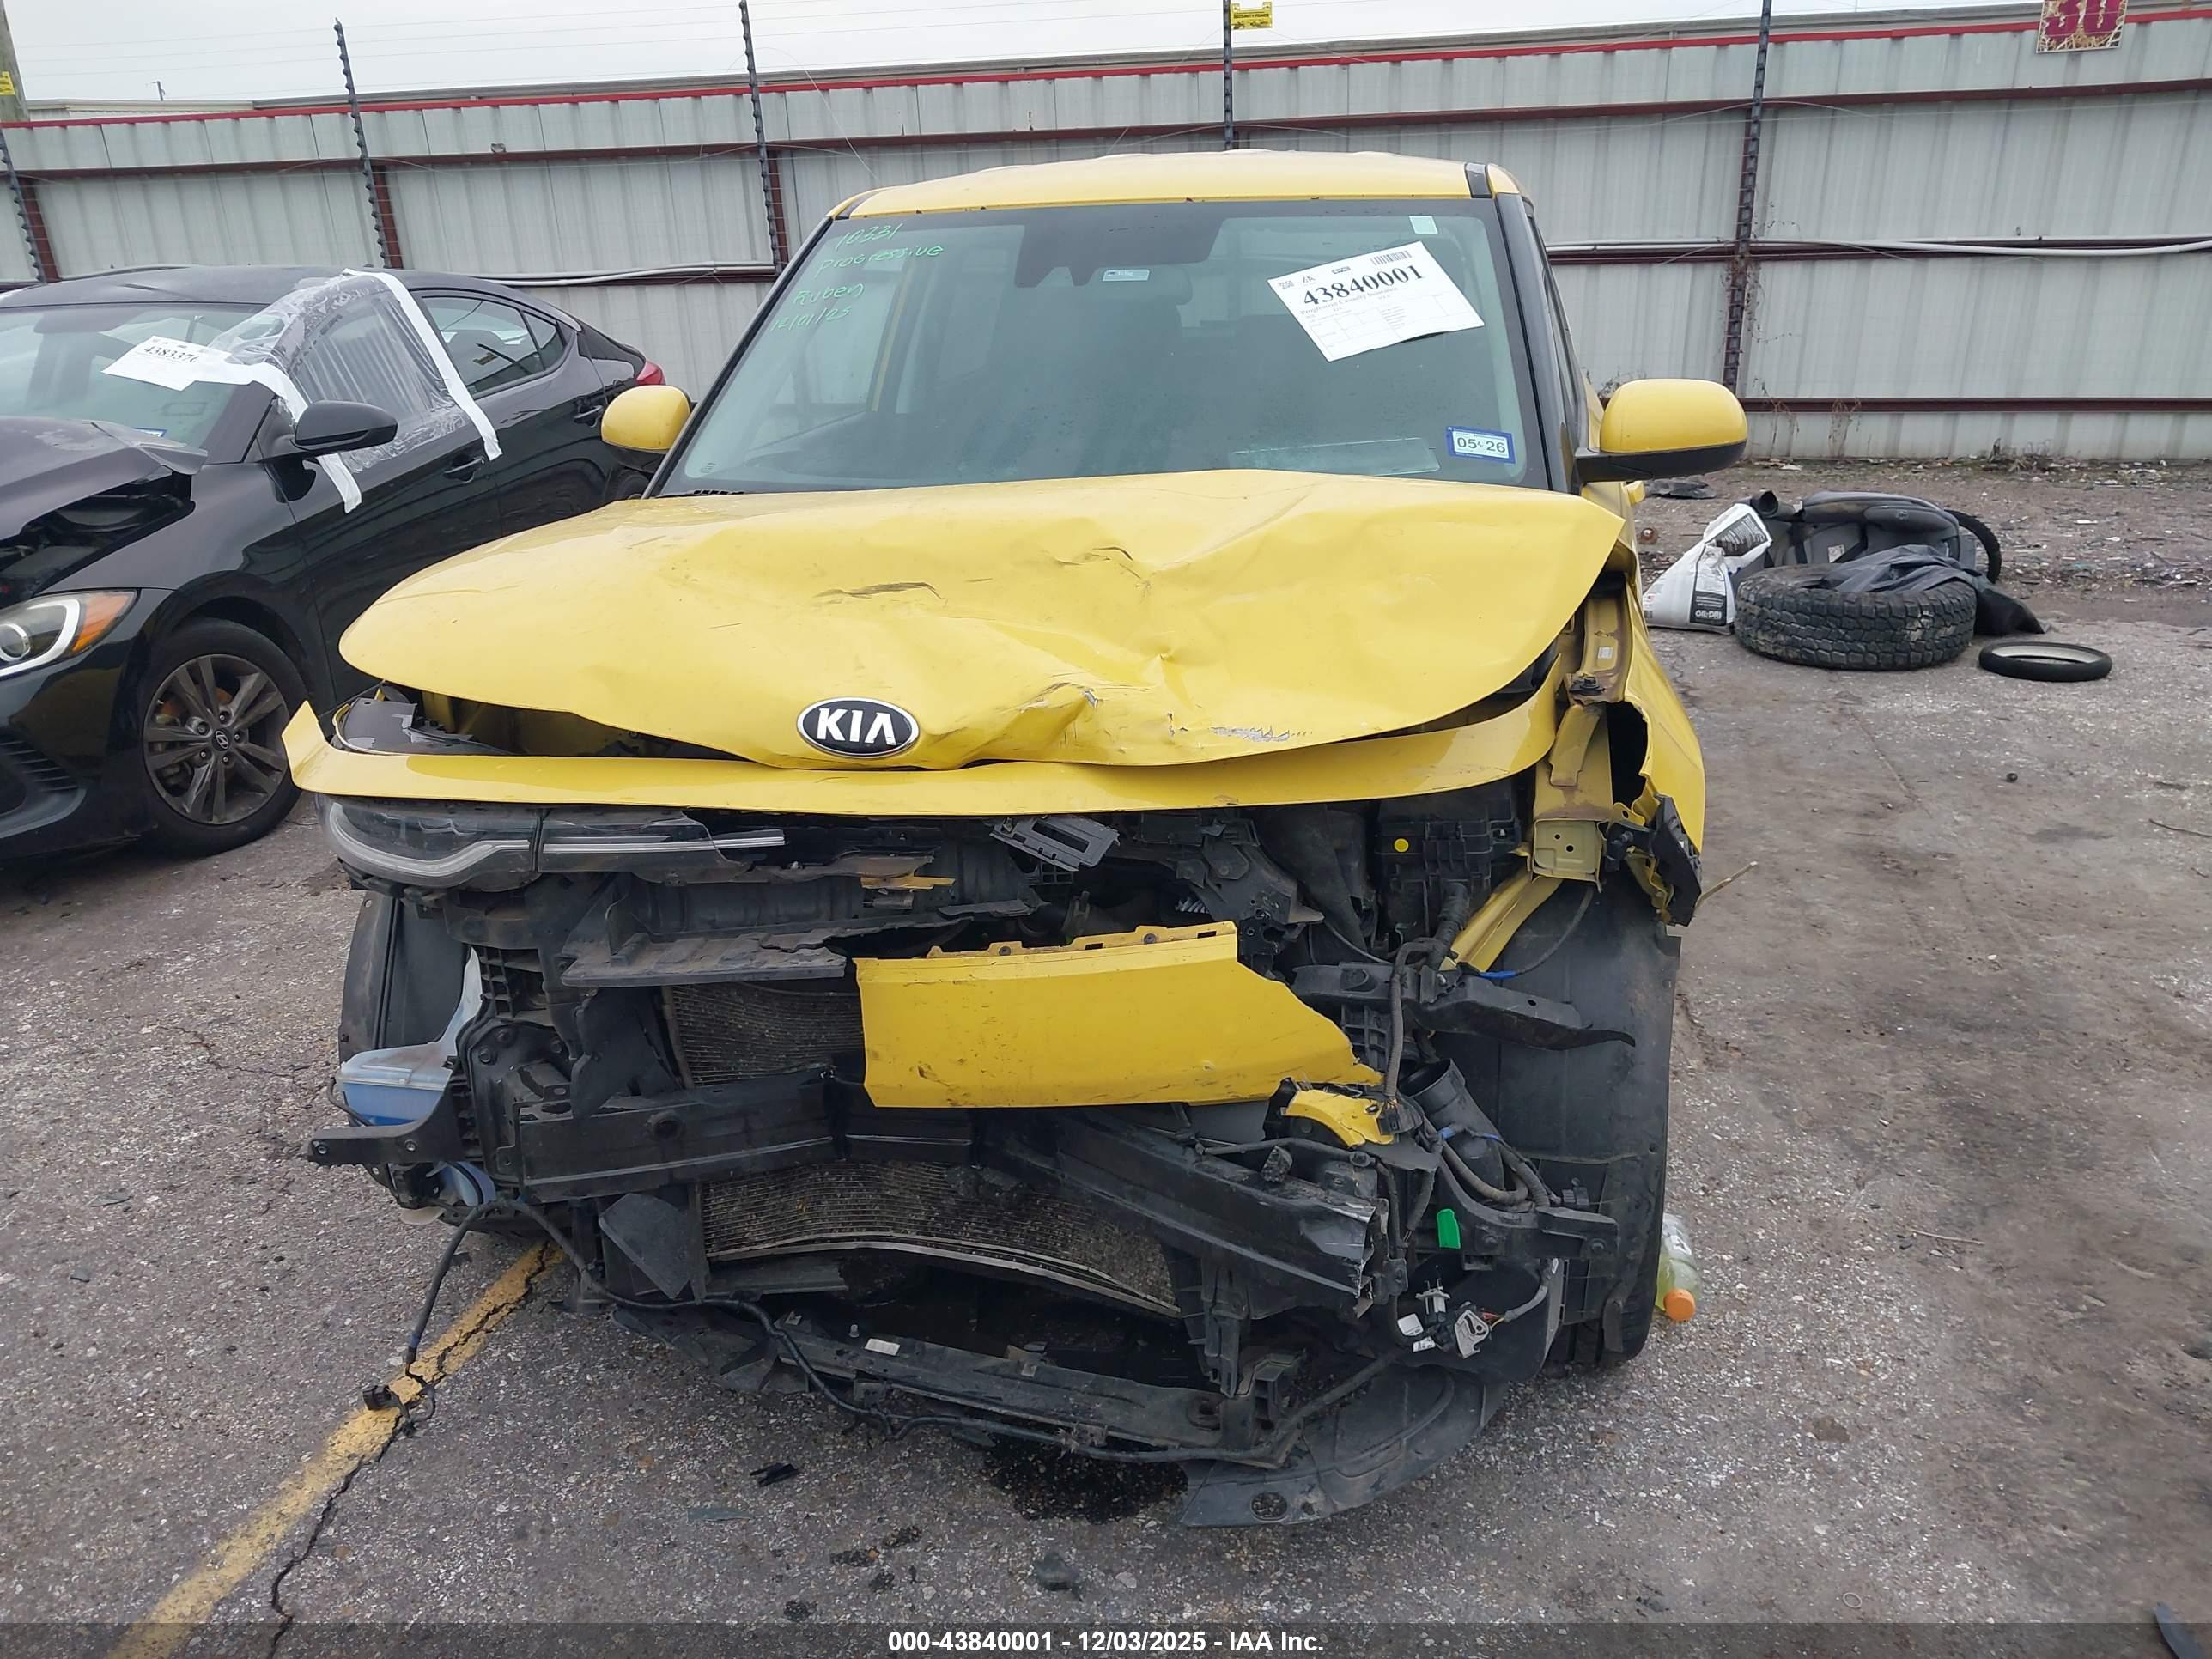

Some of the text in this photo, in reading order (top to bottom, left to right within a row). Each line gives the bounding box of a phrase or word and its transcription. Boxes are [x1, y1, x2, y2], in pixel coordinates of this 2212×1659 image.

[835, 223, 903, 250] 10331
[1303, 264, 1425, 306] 43840001
[1457, 437, 1506, 453] 05 26
[817, 708, 896, 746] KIA
